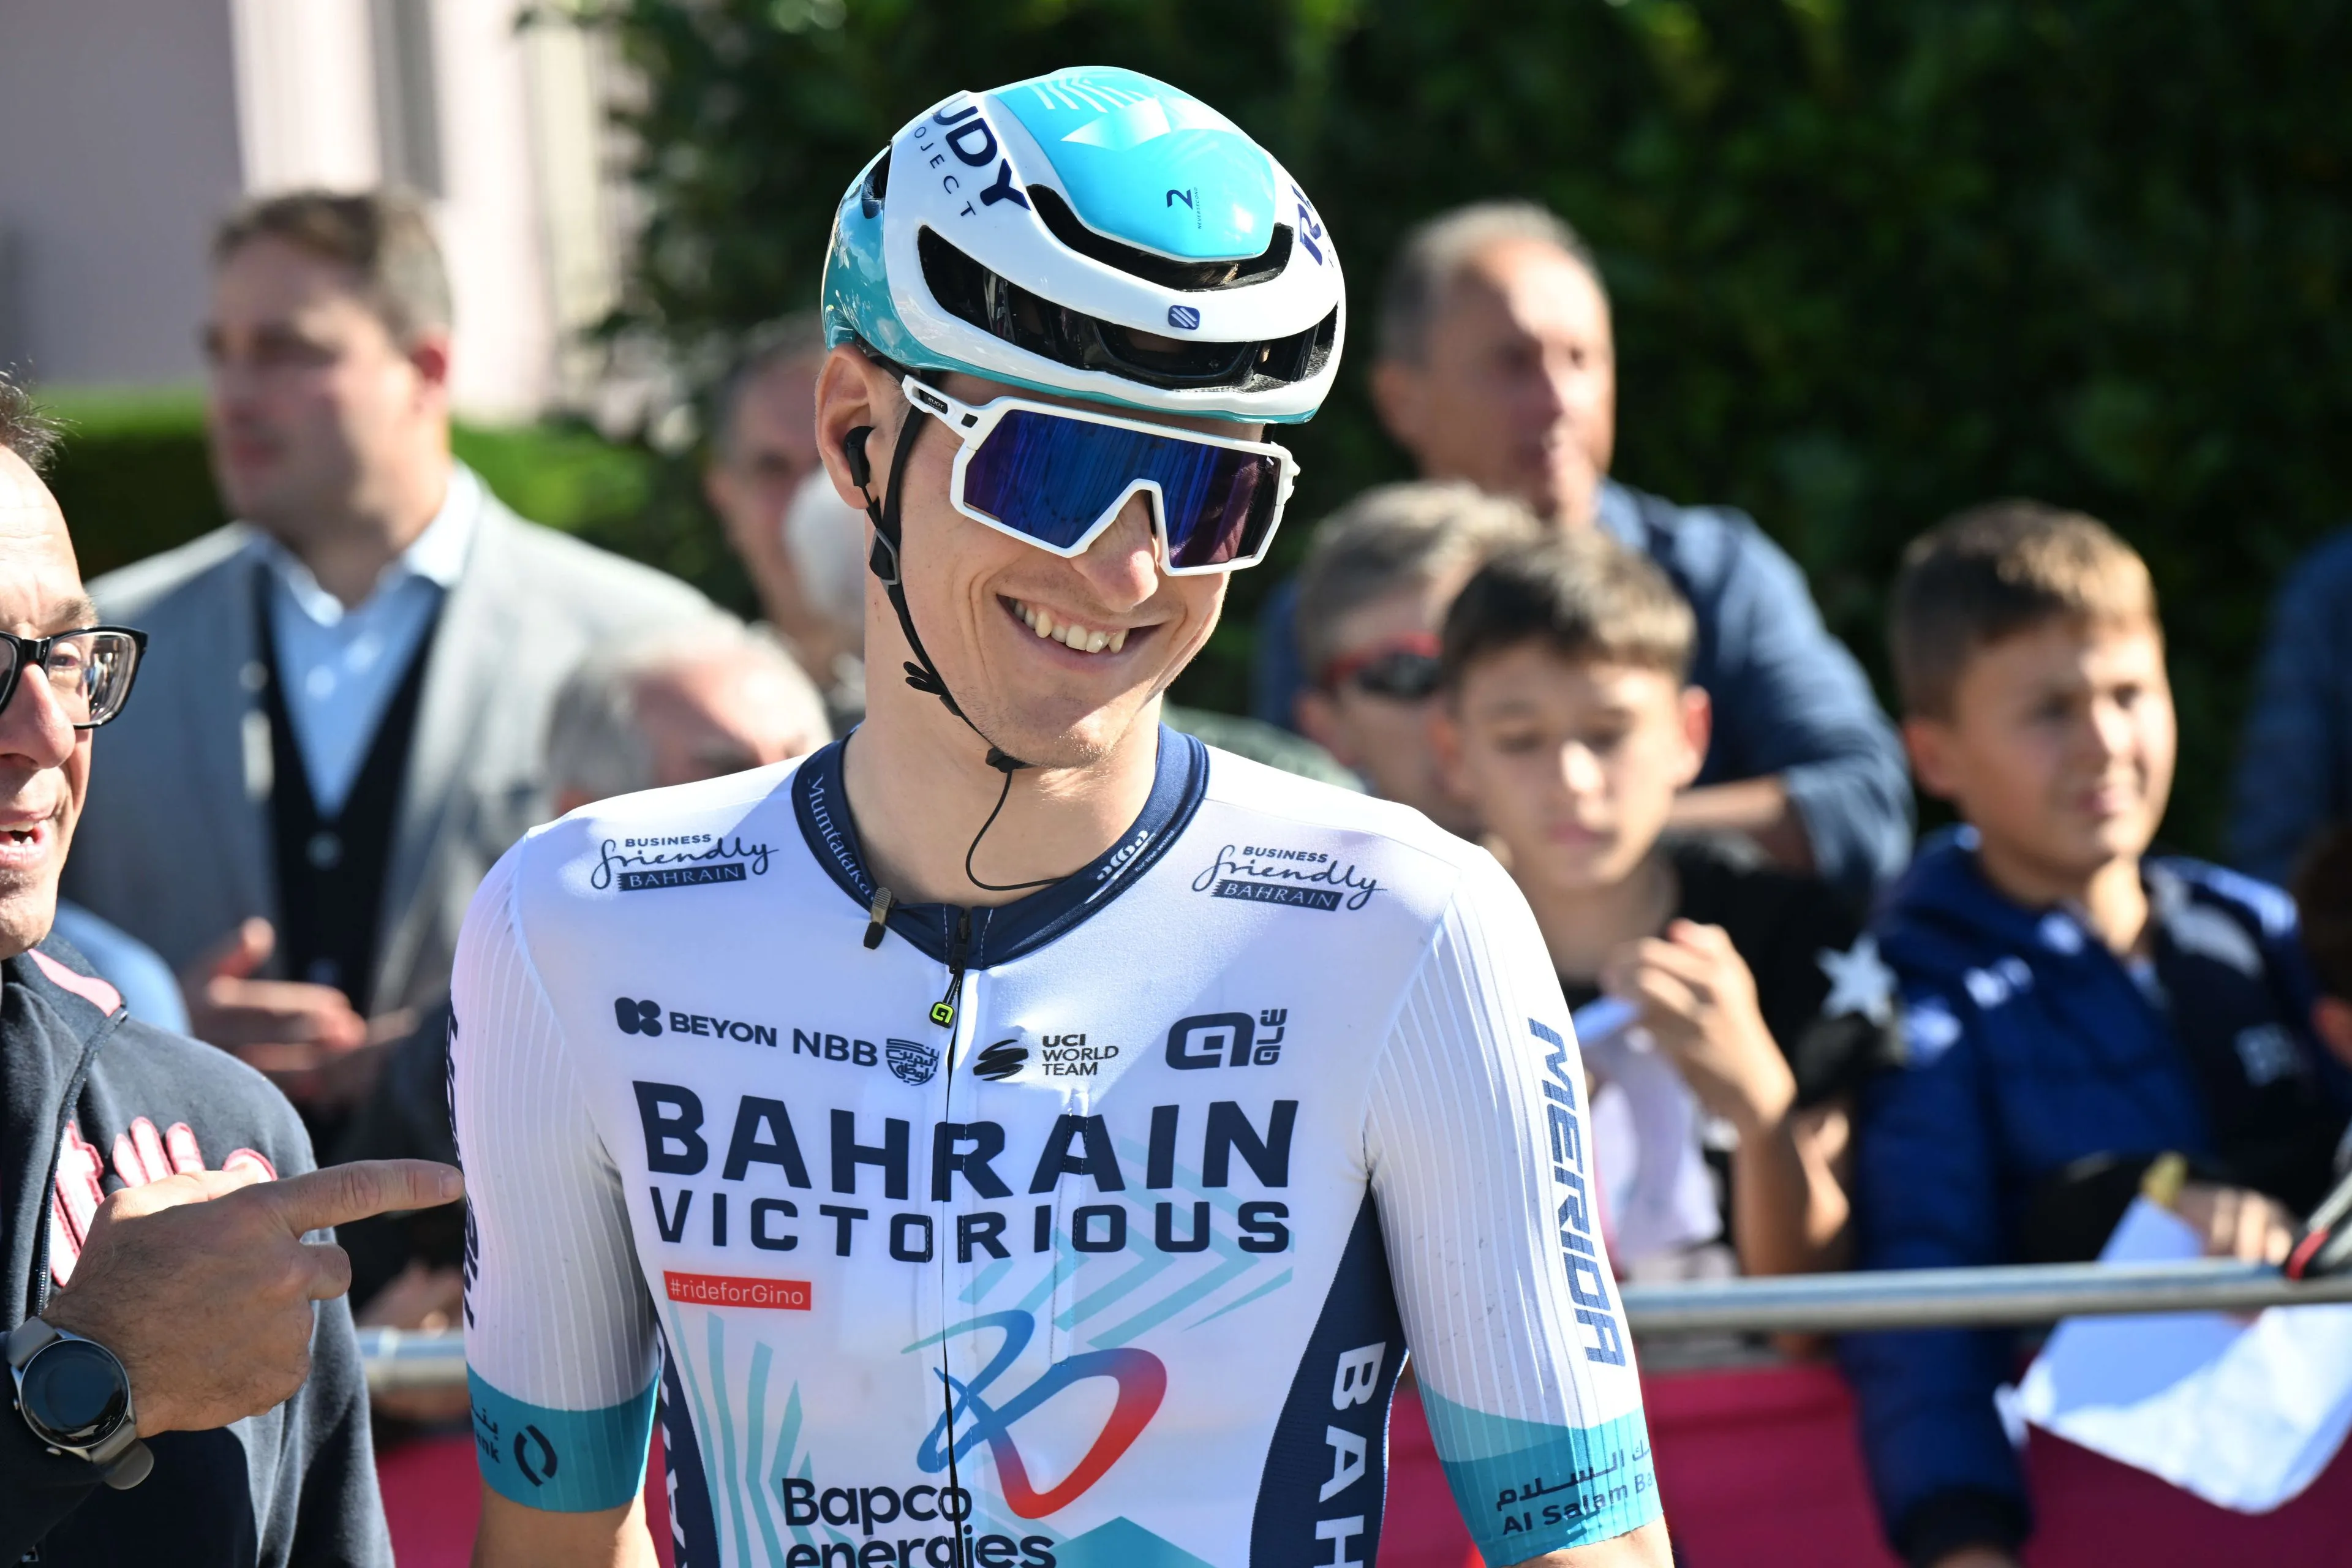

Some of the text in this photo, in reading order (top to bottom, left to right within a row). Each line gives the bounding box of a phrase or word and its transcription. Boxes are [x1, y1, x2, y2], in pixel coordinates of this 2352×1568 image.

[1193, 187, 1202, 230] NEVERSECOND
[928, 397, 944, 409] RUDY
[625, 834, 712, 848] BUSINESS
[808, 773, 875, 902] Mumtalaka
[1243, 846, 1329, 863] BUSINESS
[590, 836, 780, 889] friendly
[629, 866, 740, 888] BAHRAIN
[1191, 844, 1388, 911] friendly
[1224, 883, 1336, 908] BAHRAIN
[669, 1011, 777, 1047] BEYON
[793, 1028, 878, 1067] NBB
[1042, 1033, 1086, 1048] UCI
[1042, 1046, 1120, 1062] WORLD
[1042, 1061, 1098, 1076] TEAM
[632, 1080, 1298, 1202] BAHRAIN
[1528, 1017, 1626, 1367] MERIDA
[650, 1186, 1289, 1264] VICTORIOUS
[670, 1278, 804, 1305] #rideforGino
[782, 1477, 973, 1536] Bapco
[1502, 1512, 1533, 1536] Al
[1542, 1483, 1629, 1526] Salam
[786, 1524, 1057, 1568] energies
